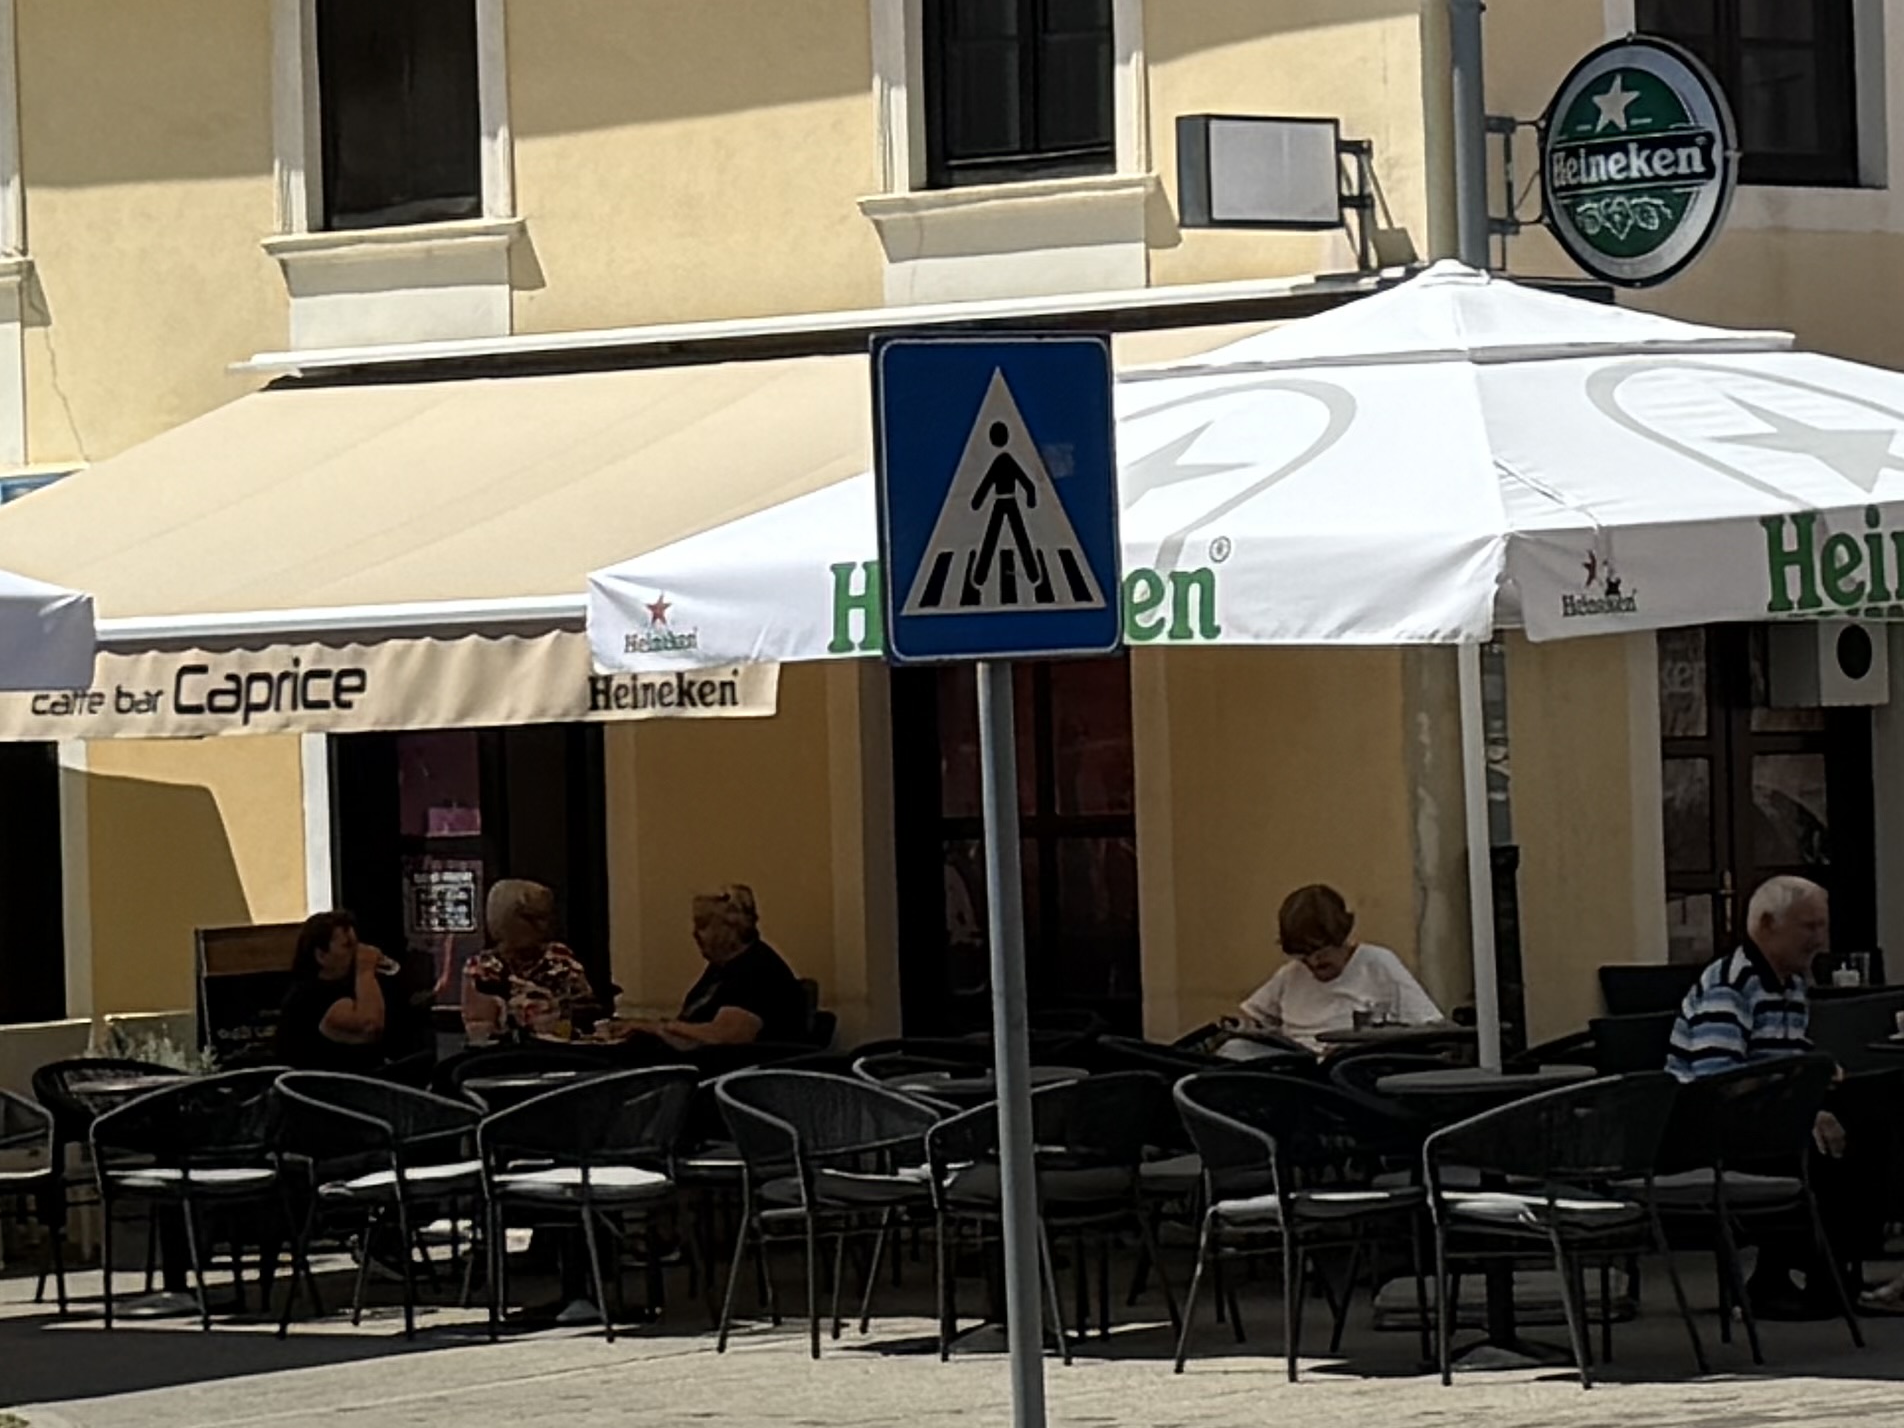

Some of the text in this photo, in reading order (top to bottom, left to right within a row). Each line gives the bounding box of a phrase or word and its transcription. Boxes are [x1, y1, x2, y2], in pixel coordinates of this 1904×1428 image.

[1552, 142, 1707, 188] Heineken
[114, 685, 163, 715] bar
[174, 657, 367, 725] Caprice
[588, 671, 739, 711] Heineken
